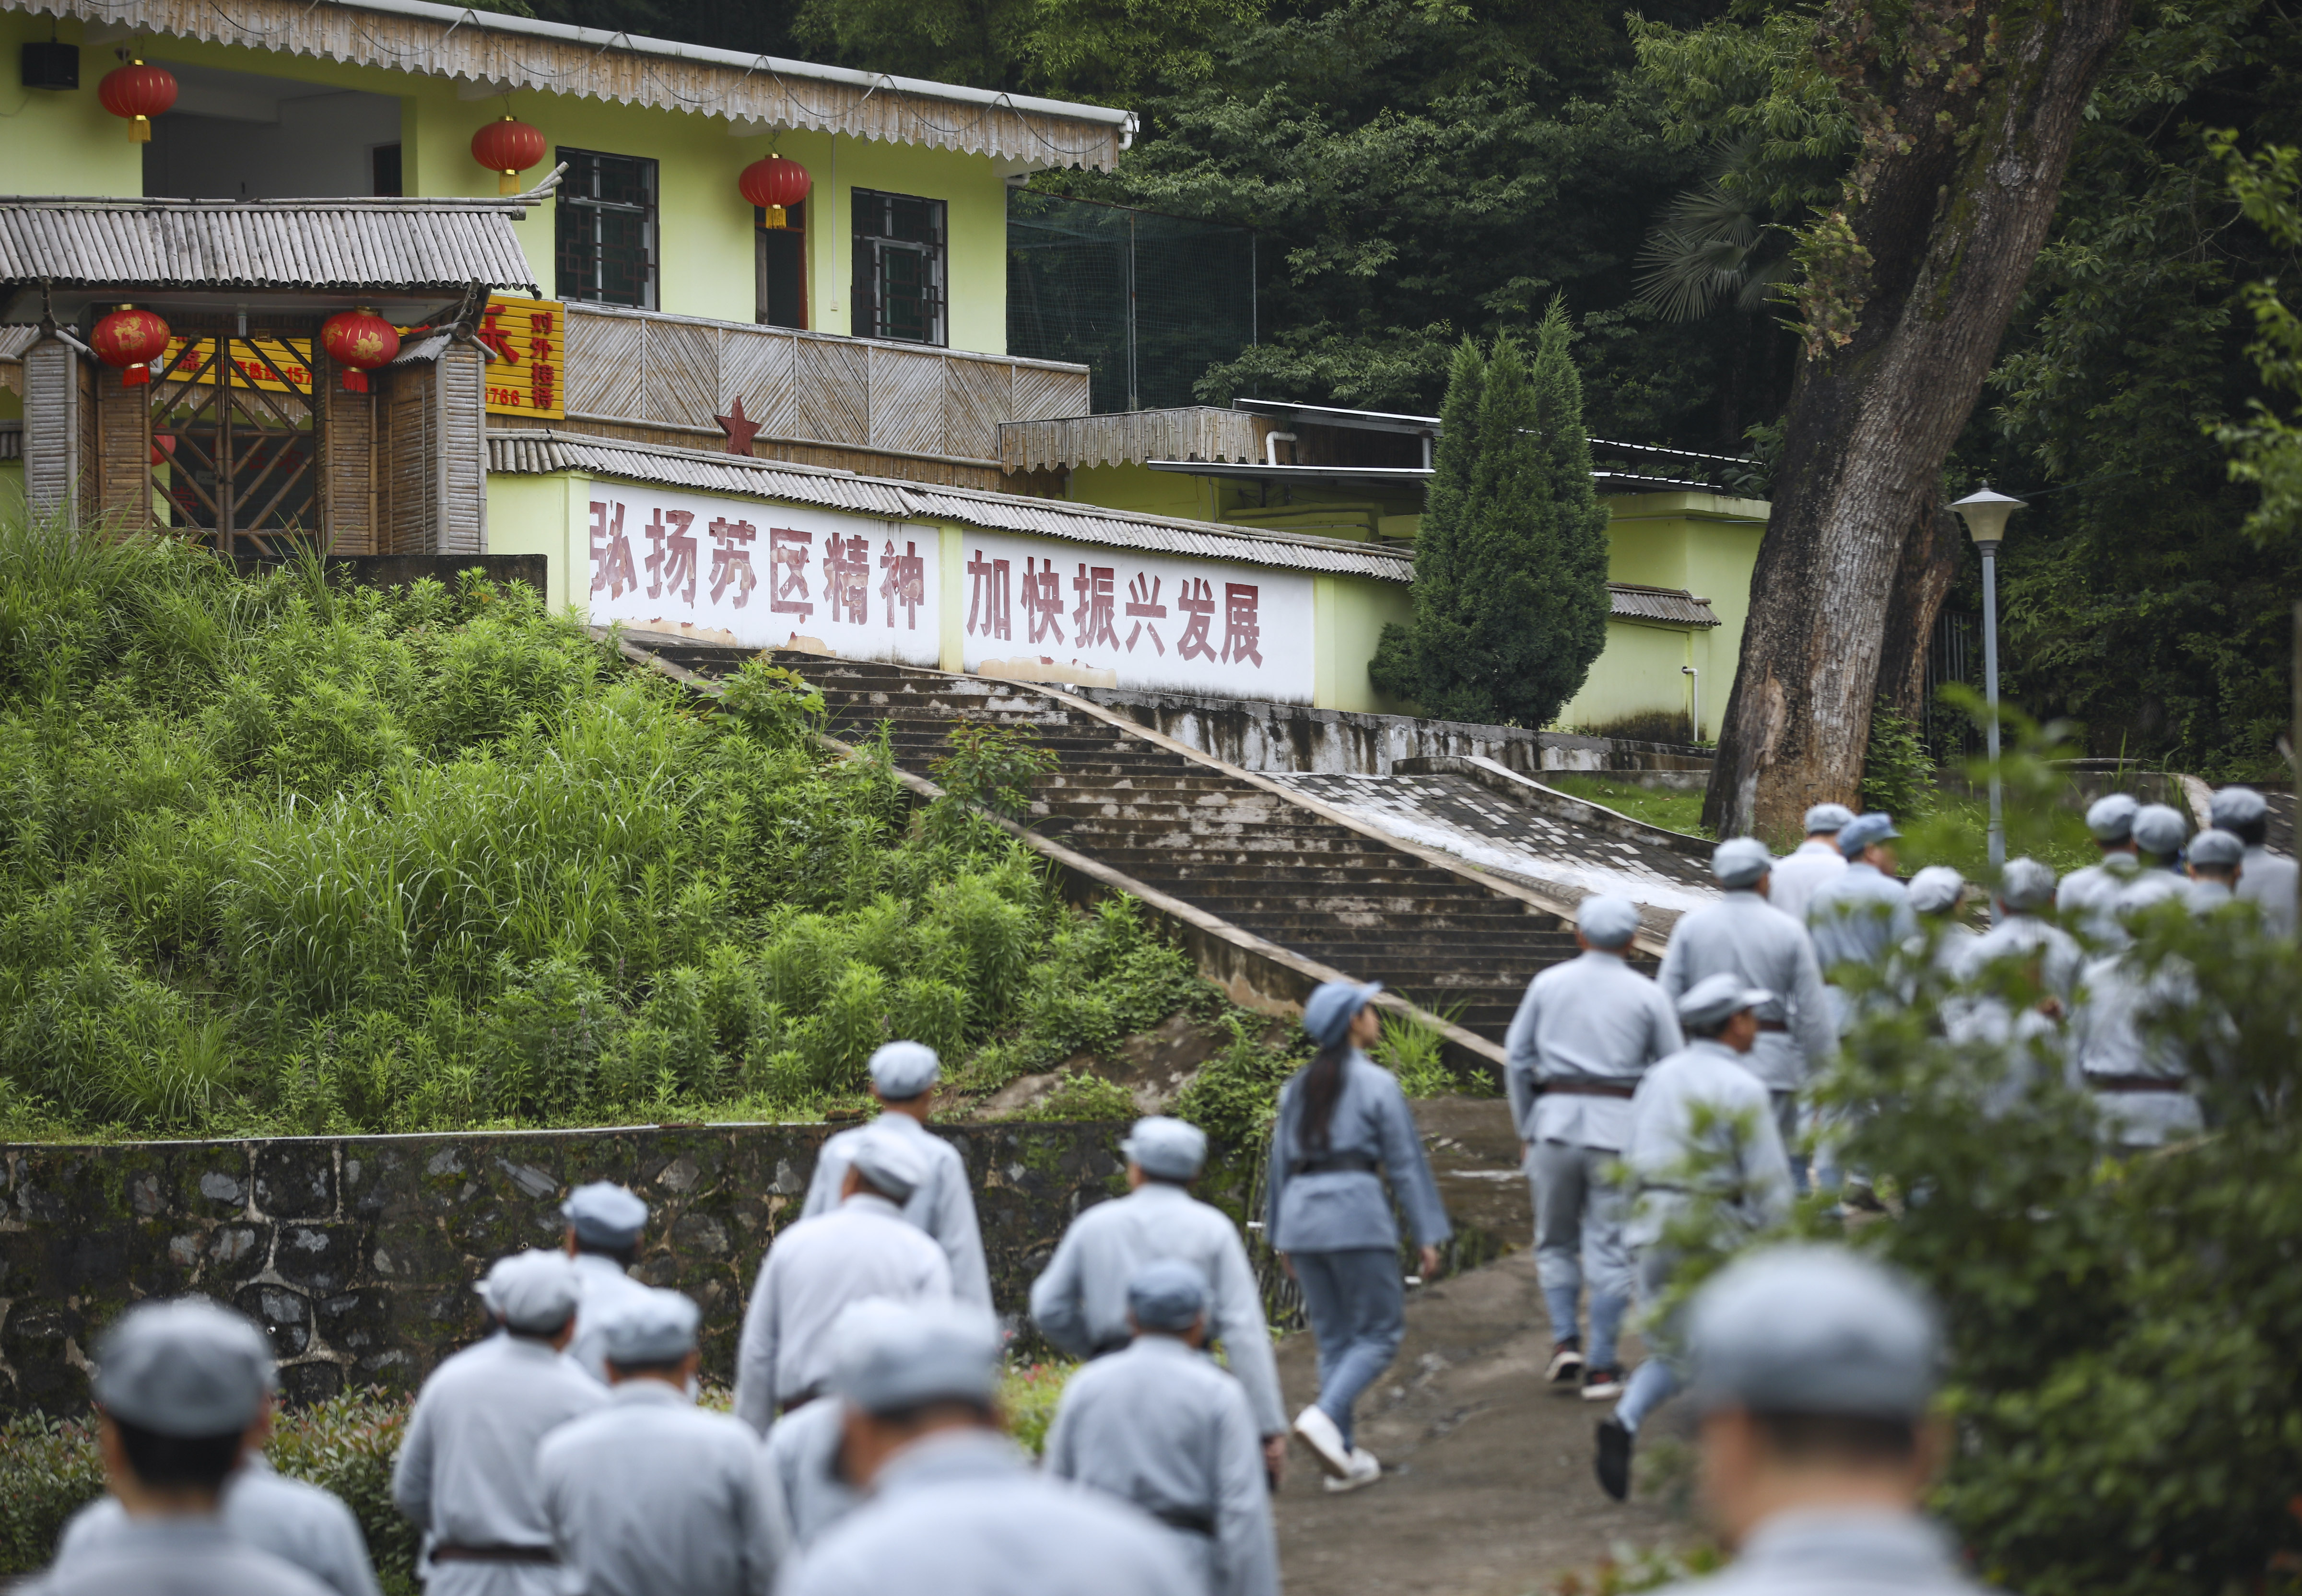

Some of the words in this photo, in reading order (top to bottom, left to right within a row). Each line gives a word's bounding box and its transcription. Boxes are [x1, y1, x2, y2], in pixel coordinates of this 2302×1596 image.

[530, 312, 554, 408] 对外接待
[590, 499, 925, 630] 弘扬苏区精神
[966, 549, 1264, 669] 加快振兴发展
